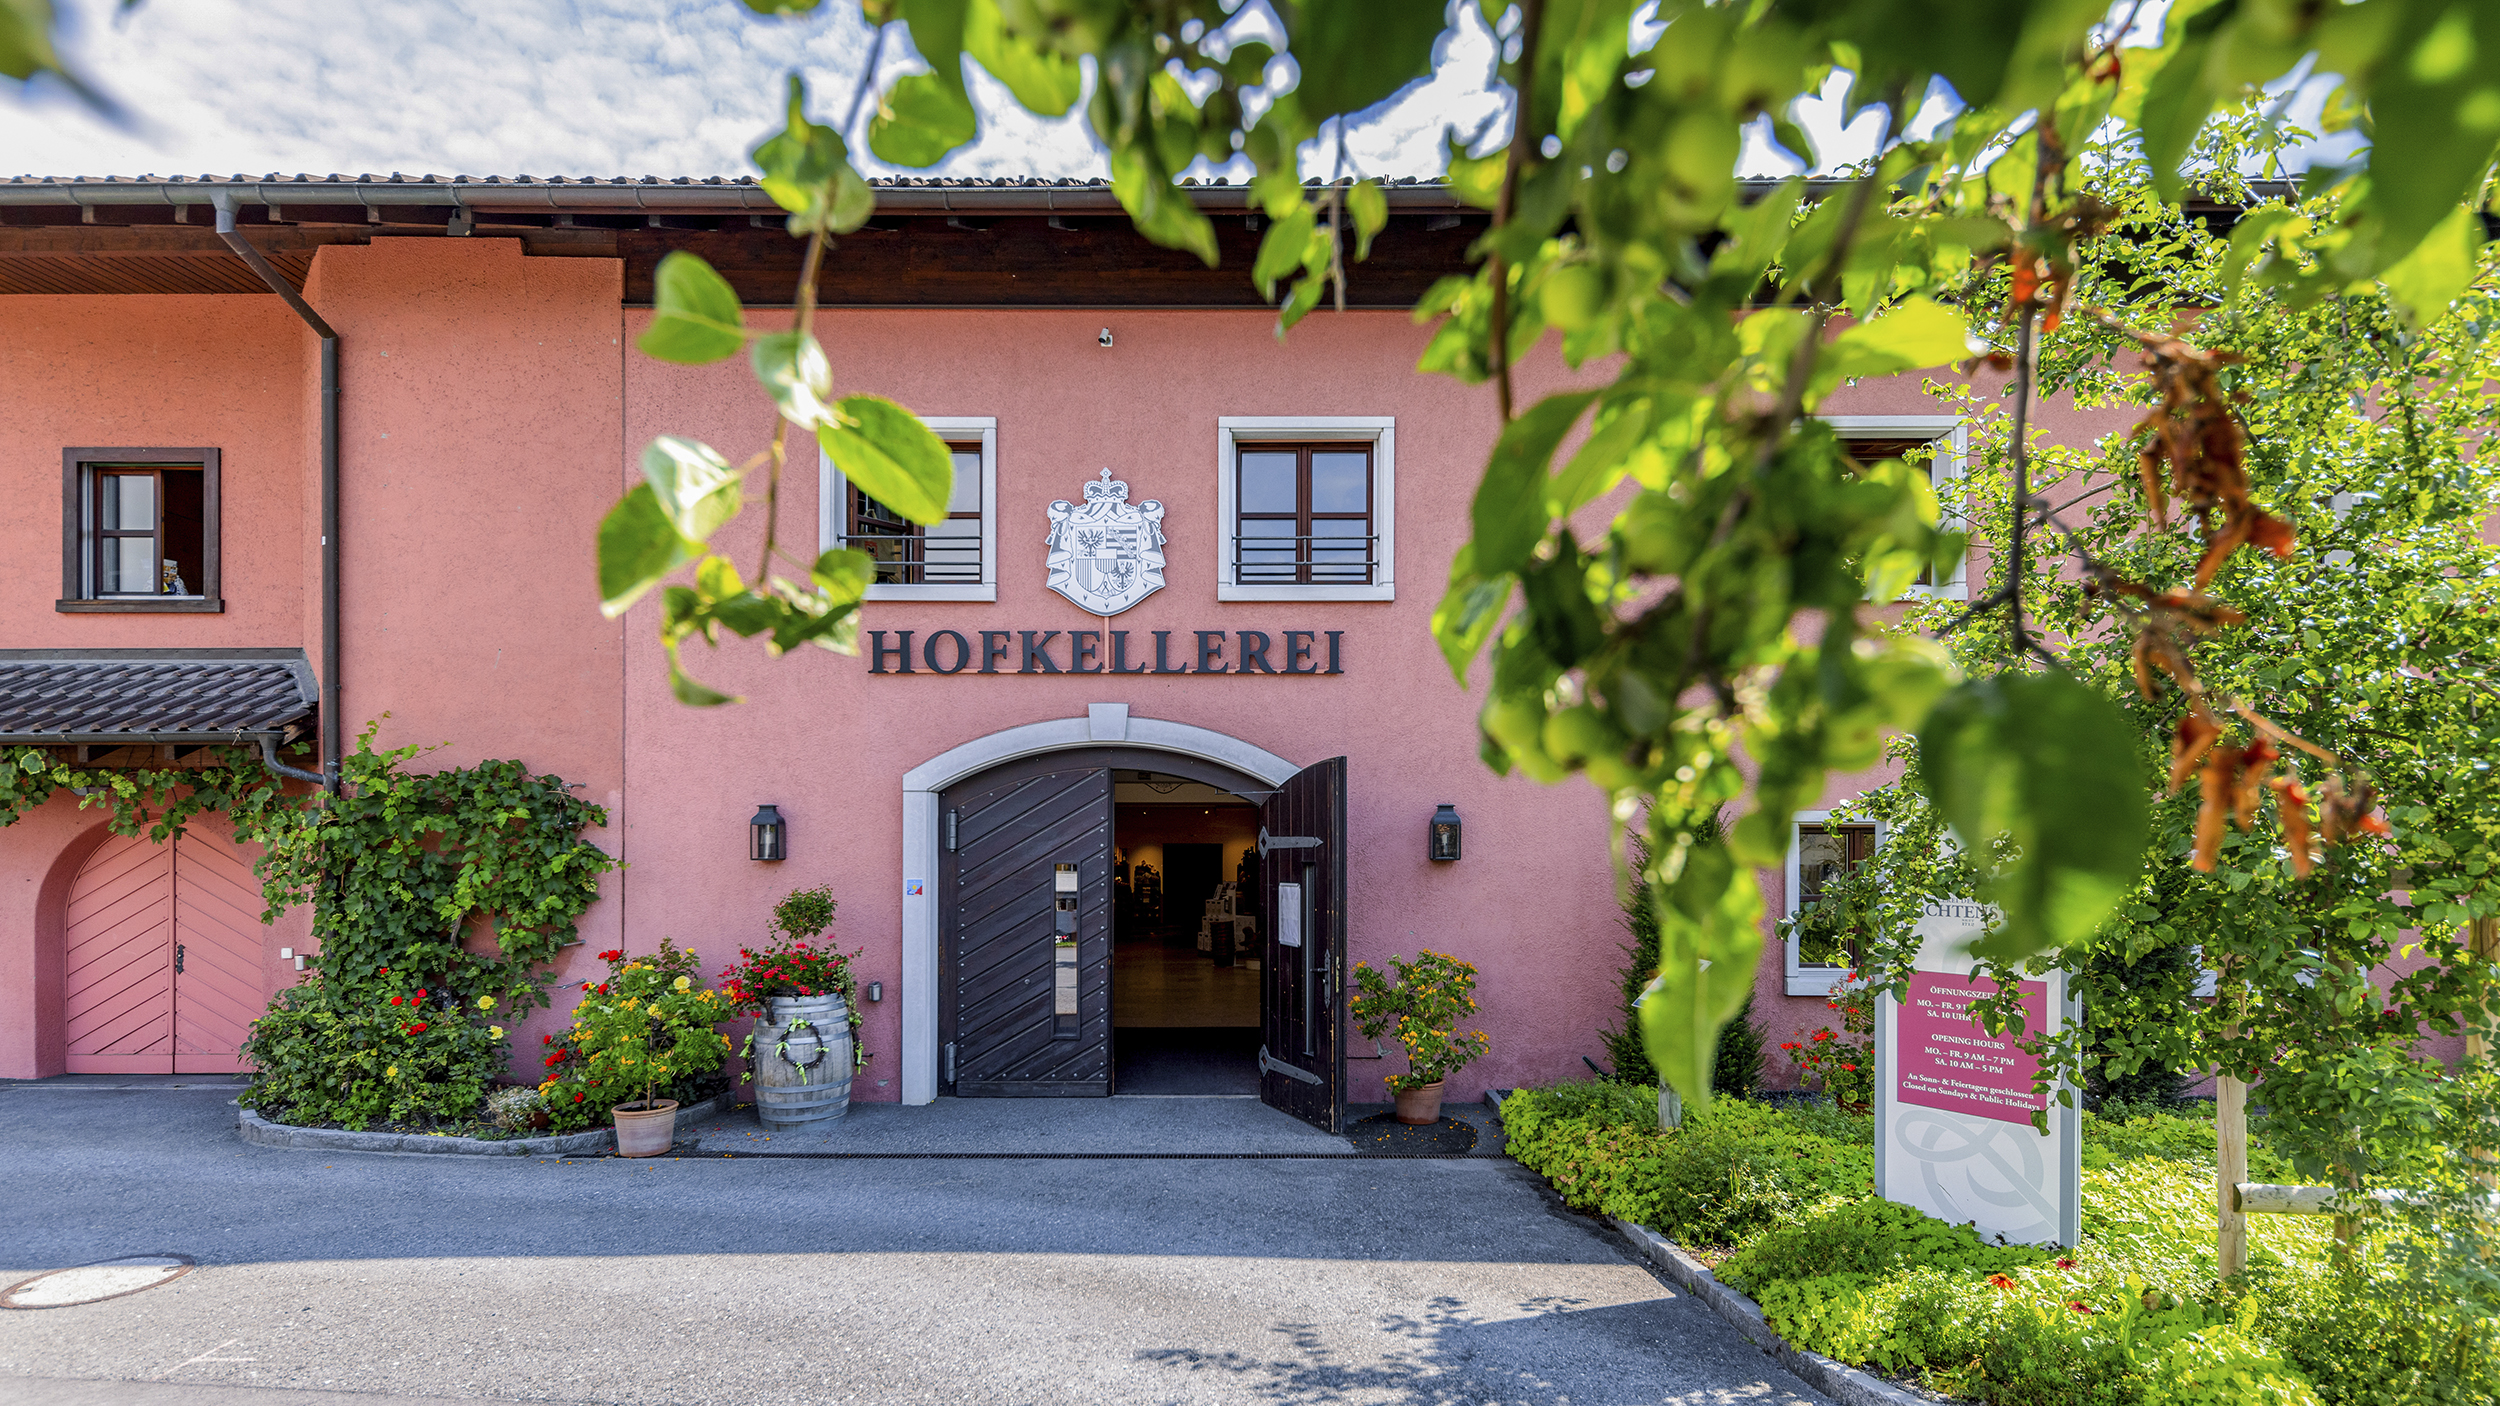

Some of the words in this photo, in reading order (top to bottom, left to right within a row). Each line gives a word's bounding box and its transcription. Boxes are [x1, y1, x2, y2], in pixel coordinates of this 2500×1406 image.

[867, 629, 1345, 674] HOFKELLEREI
[1916, 999, 1934, 1008] MO.
[1941, 1001, 1955, 1010] FR.
[1956, 1003, 1962, 1011] 9
[1927, 1009, 1940, 1018] SA.
[1941, 1011, 1951, 1019] 10
[1951, 1012, 1972, 1022] UHR
[1931, 1033, 1972, 1046] OPENING
[1972, 1038, 2006, 1050] HOURS
[1924, 1046, 1942, 1056] MO.
[1949, 1049, 1963, 1059] FR.
[1963, 1052, 1970, 1060] 9
[1970, 1053, 1985, 1062] AM
[2000, 1056, 2015, 1066] PM
[1934, 1057, 1948, 1066] SA.
[1949, 1059, 1959, 1068] 10
[1959, 1061, 1974, 1070] AM
[1982, 1064, 1988, 1072] 5
[1988, 1065, 2003, 1074] PM
[1907, 1072, 1918, 1080] An
[1918, 1073, 1940, 1084] Sonn-
[1941, 1077, 1950, 1086] &
[1950, 1078, 1989, 1093] Feiertagen
[1989, 1087, 2034, 1100] geschlossen
[1902, 1080, 1927, 1091] Closed
[1938, 1086, 1968, 1100] Sundays
[1969, 1092, 1977, 1100] &
[1979, 1093, 2003, 1105] Public
[2004, 1097, 2040, 1111] Holidays
